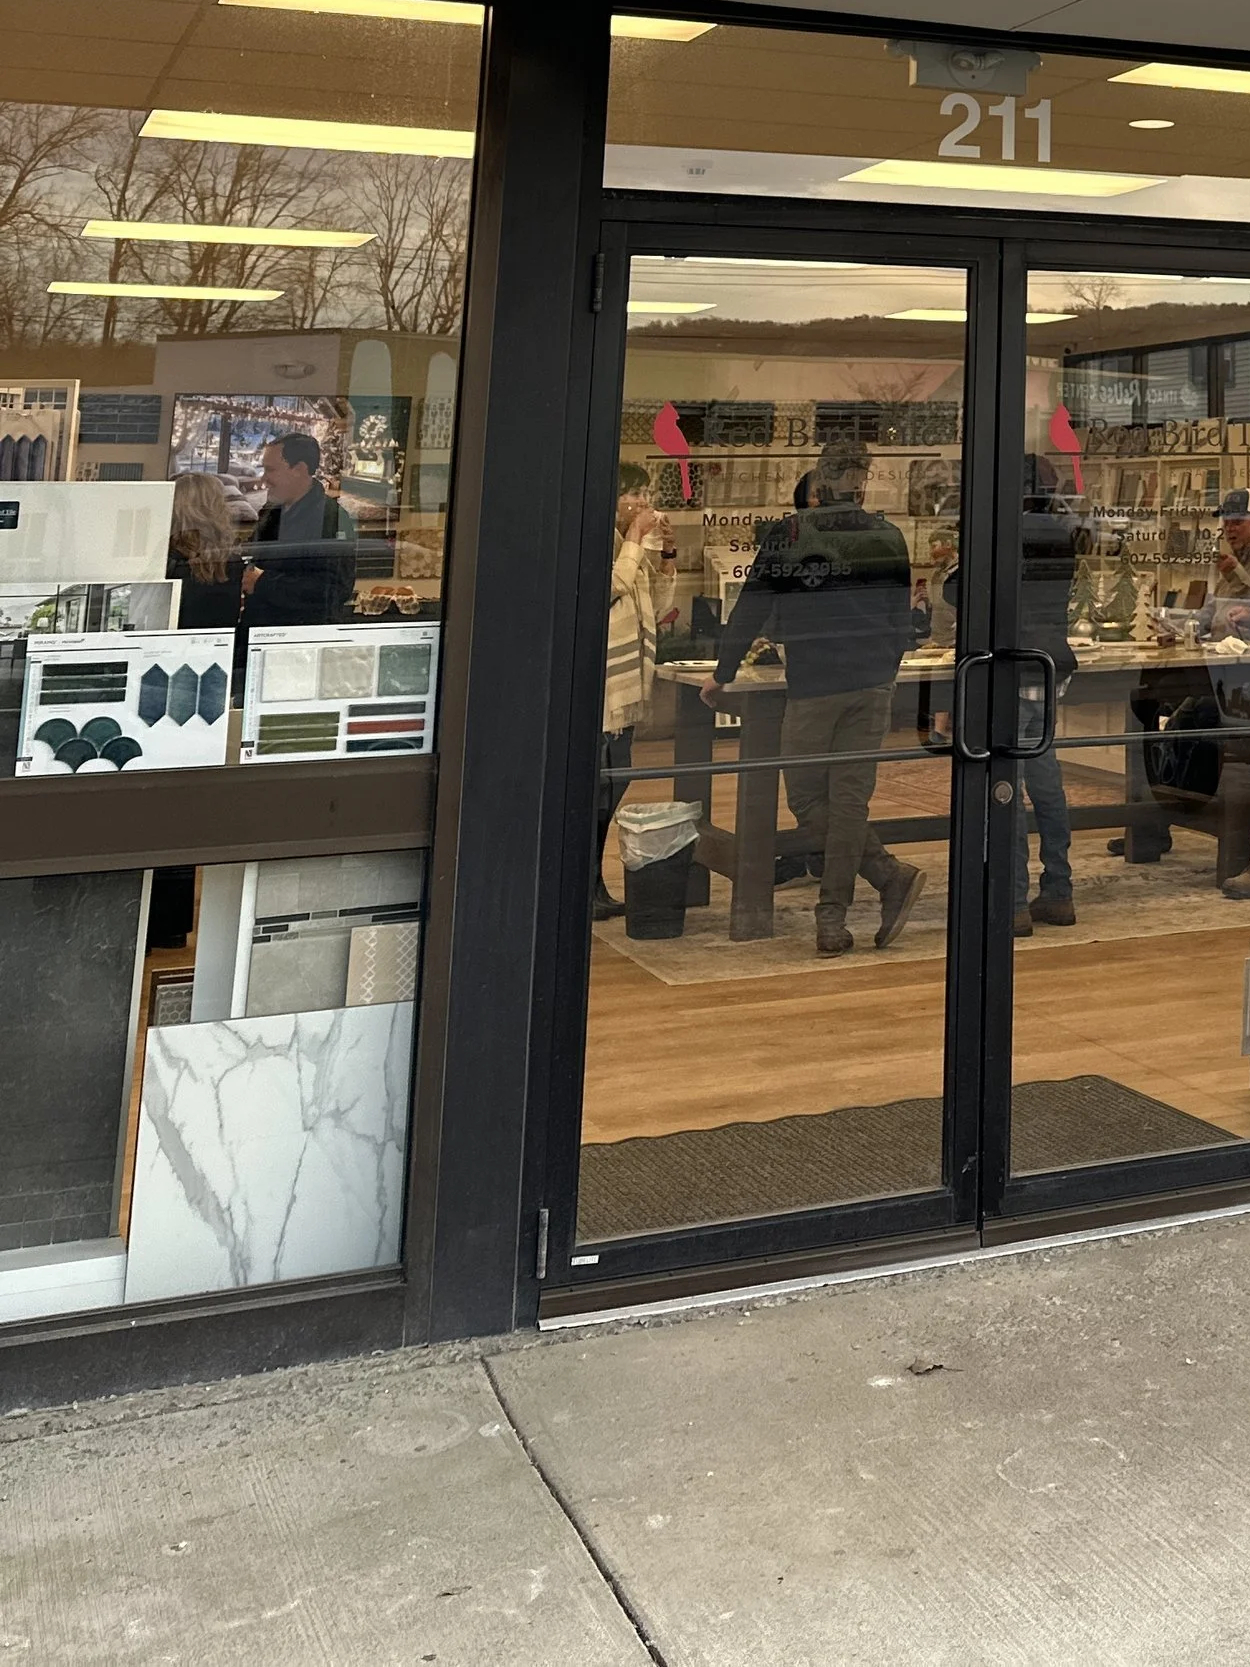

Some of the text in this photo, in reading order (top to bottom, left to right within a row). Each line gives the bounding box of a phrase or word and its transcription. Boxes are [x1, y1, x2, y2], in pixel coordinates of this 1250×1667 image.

[937, 92, 1052, 163] 211
[702, 416, 773, 448] Red
[784, 417, 860, 448] Bird
[1161, 418, 1226, 447] Bird
[709, 470, 786, 483] KITCHEN
[816, 469, 859, 482] BH
